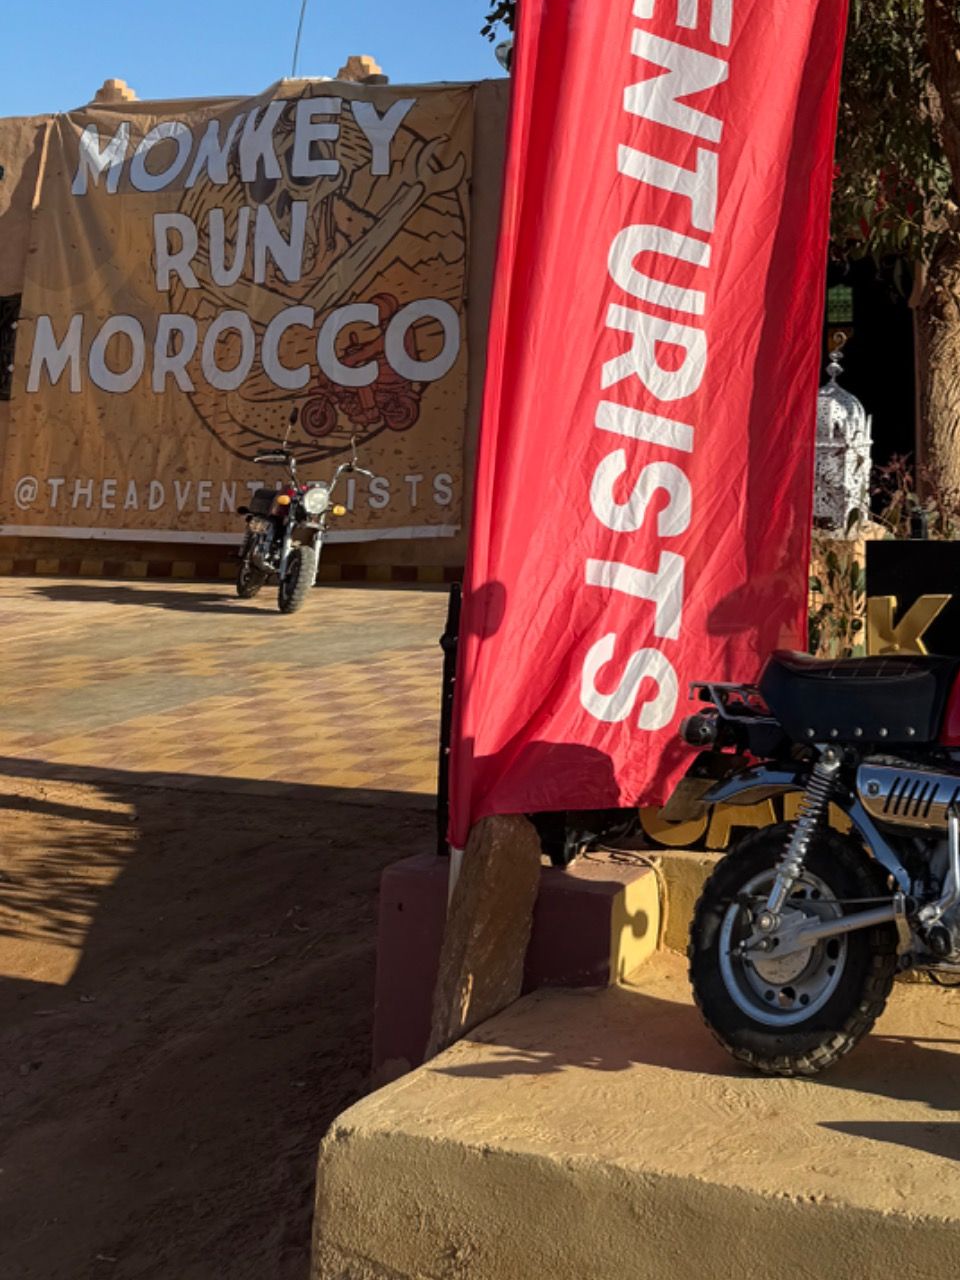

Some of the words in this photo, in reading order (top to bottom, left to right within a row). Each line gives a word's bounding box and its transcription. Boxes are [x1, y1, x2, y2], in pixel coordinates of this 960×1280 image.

[71, 97, 416, 197] MONKEY
[153, 200, 309, 292] RUN
[26, 297, 461, 394] MOROCCO
[14, 472, 455, 513] @THEADVENISTS
